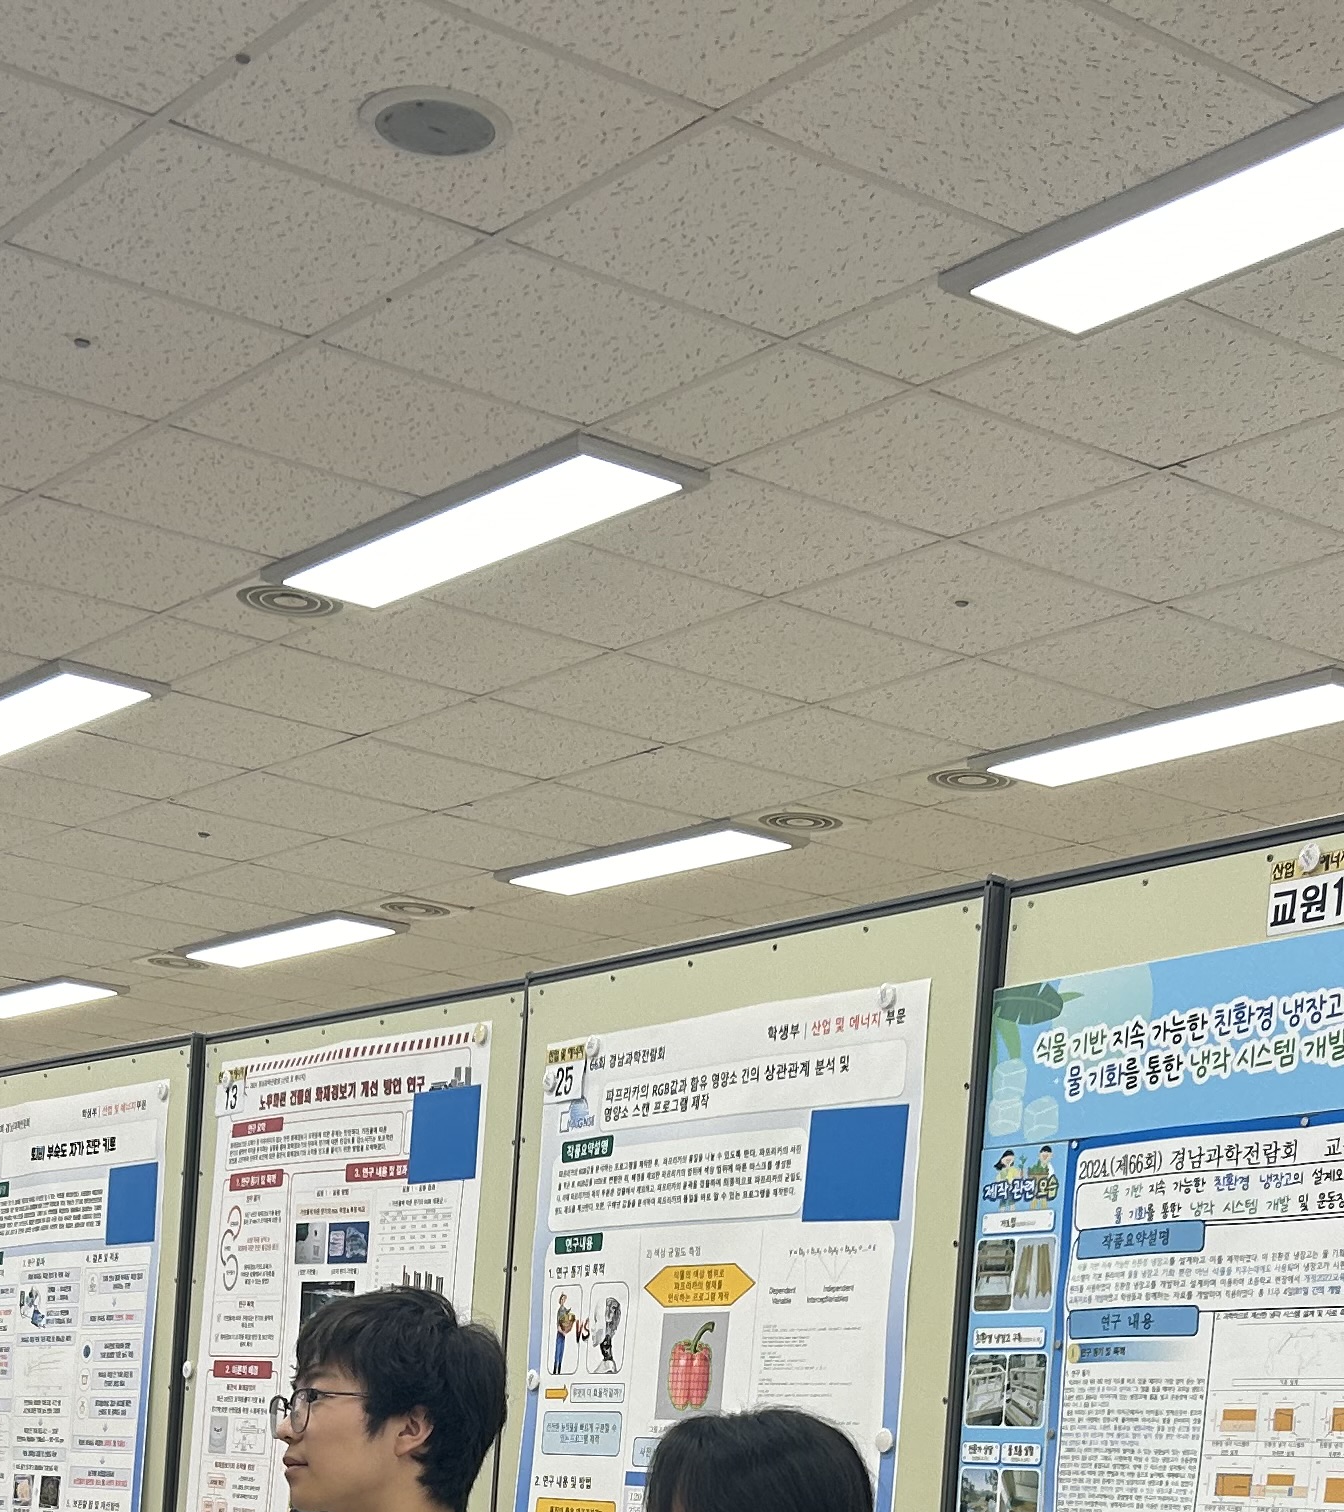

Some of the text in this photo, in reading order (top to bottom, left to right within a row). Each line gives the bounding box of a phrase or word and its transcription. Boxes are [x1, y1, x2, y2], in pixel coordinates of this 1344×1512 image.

[1273, 860, 1295, 881] 산업
[1270, 876, 1344, 927] 교원1
[768, 1022, 800, 1042] 학생부
[885, 1007, 906, 1026] 부문
[1037, 1032, 1066, 1062] 식물
[1072, 1028, 1107, 1056] 기반
[1113, 1023, 1145, 1049] 지속
[1152, 1012, 1208, 1043] 가능한
[1214, 1002, 1274, 1036] 친환경
[651, 1077, 687, 1097] RGB값과
[711, 1069, 738, 1090] 영양소
[763, 1059, 811, 1082] 상관관계
[814, 1057, 836, 1076] 분석
[839, 1054, 850, 1073] 및
[1067, 1066, 1083, 1097] 물
[1089, 1056, 1141, 1091] 기화를
[1146, 1054, 1184, 1085] 통한
[1190, 1050, 1231, 1078] 냉각
[1237, 1037, 1296, 1068] 시스템
[406, 1075, 426, 1094] 연구
[555, 1066, 574, 1097] 25
[225, 1085, 238, 1111] 13
[604, 1103, 629, 1123] 영양소
[1169, 1139, 1298, 1171] 경남과학전람회
[983, 1183, 1010, 1201] 제작
[1011, 1180, 1036, 1199] 관련
[1172, 1176, 1207, 1195] 가능한
[1213, 1172, 1251, 1193] 친환경
[1258, 1169, 1304, 1190] 냉장고의
[1189, 1199, 1216, 1216] 냉각
[1222, 1198, 1259, 1215] 시스템
[1265, 1195, 1292, 1213] 개발
[566, 1237, 593, 1252] 연구내용
[1101, 1228, 1171, 1250] 작품요약설명
[1101, 1312, 1155, 1331] 연구 내용
